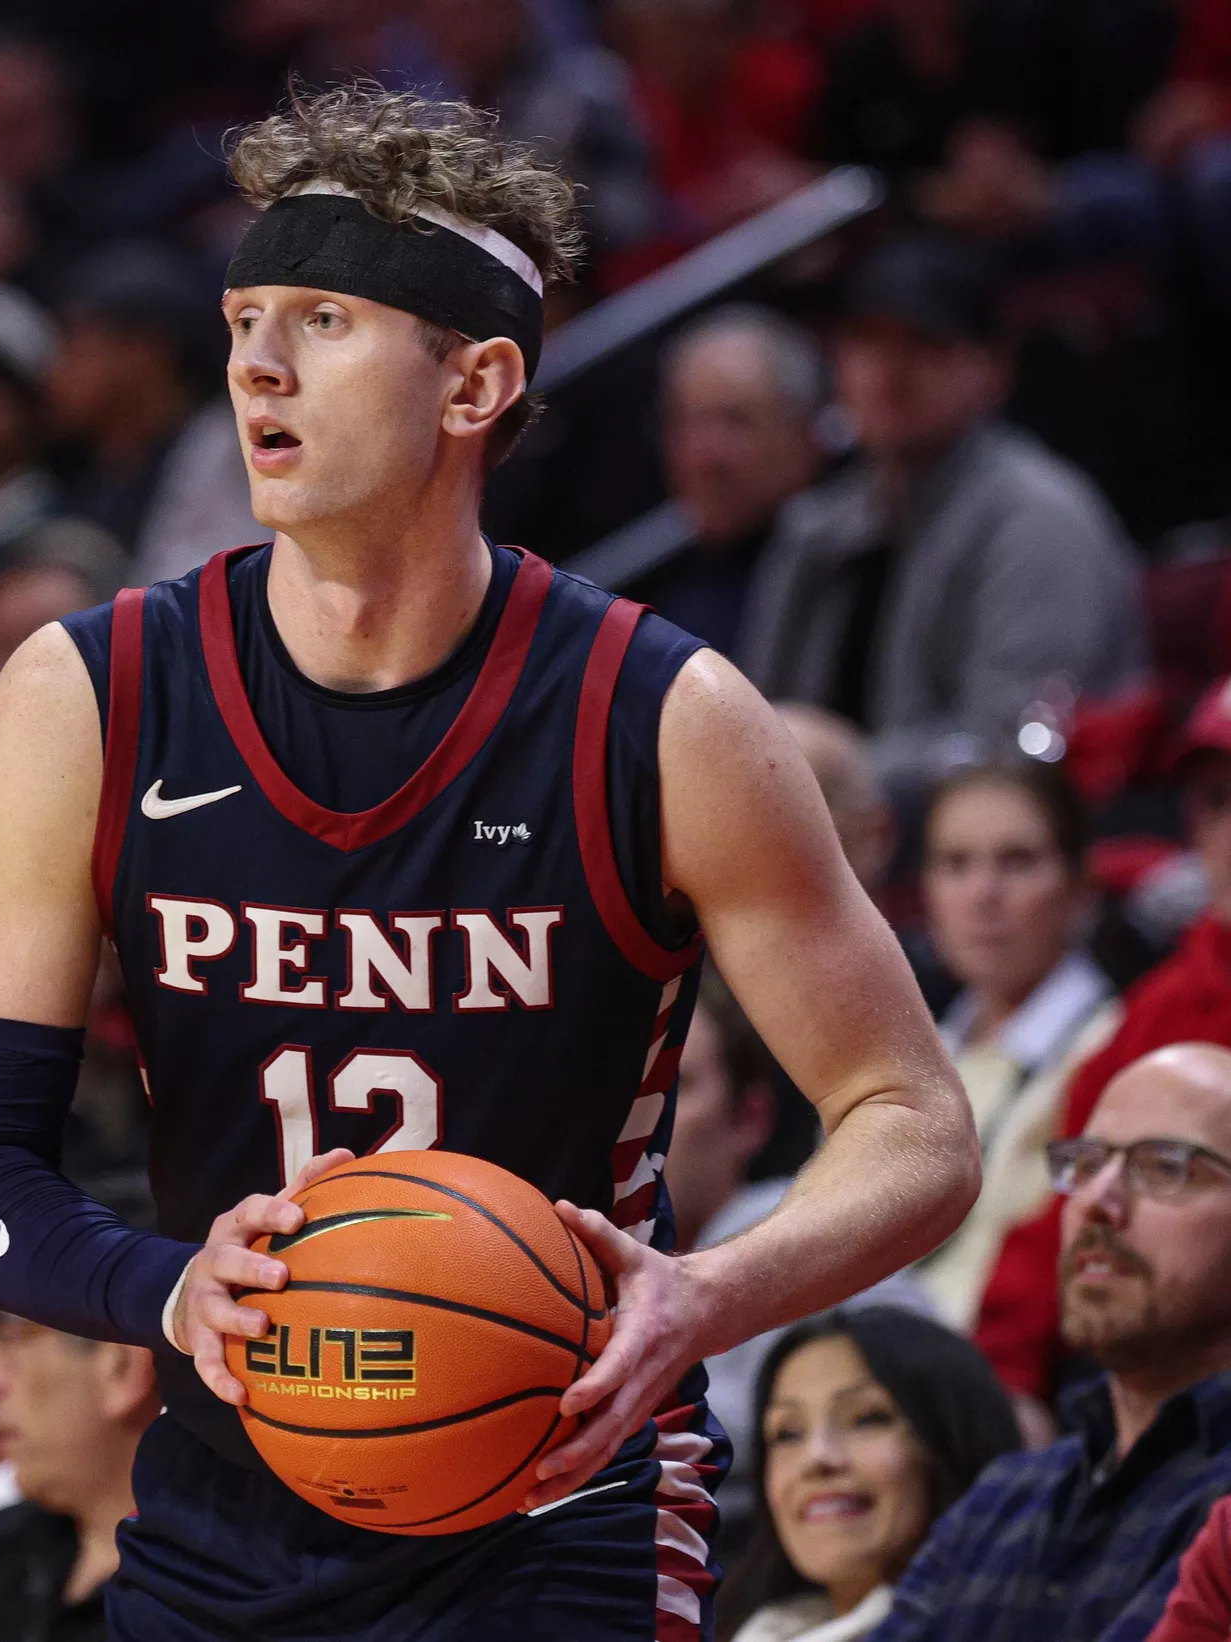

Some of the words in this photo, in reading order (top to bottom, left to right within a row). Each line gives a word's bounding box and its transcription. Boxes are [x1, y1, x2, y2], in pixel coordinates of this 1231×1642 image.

[473, 820, 511, 845] Ivy
[145, 892, 564, 1013] PENN
[259, 1043, 443, 1189] 12
[245, 1324, 416, 1383] ELITE
[249, 1378, 417, 1400] HAMPIONSHIP
